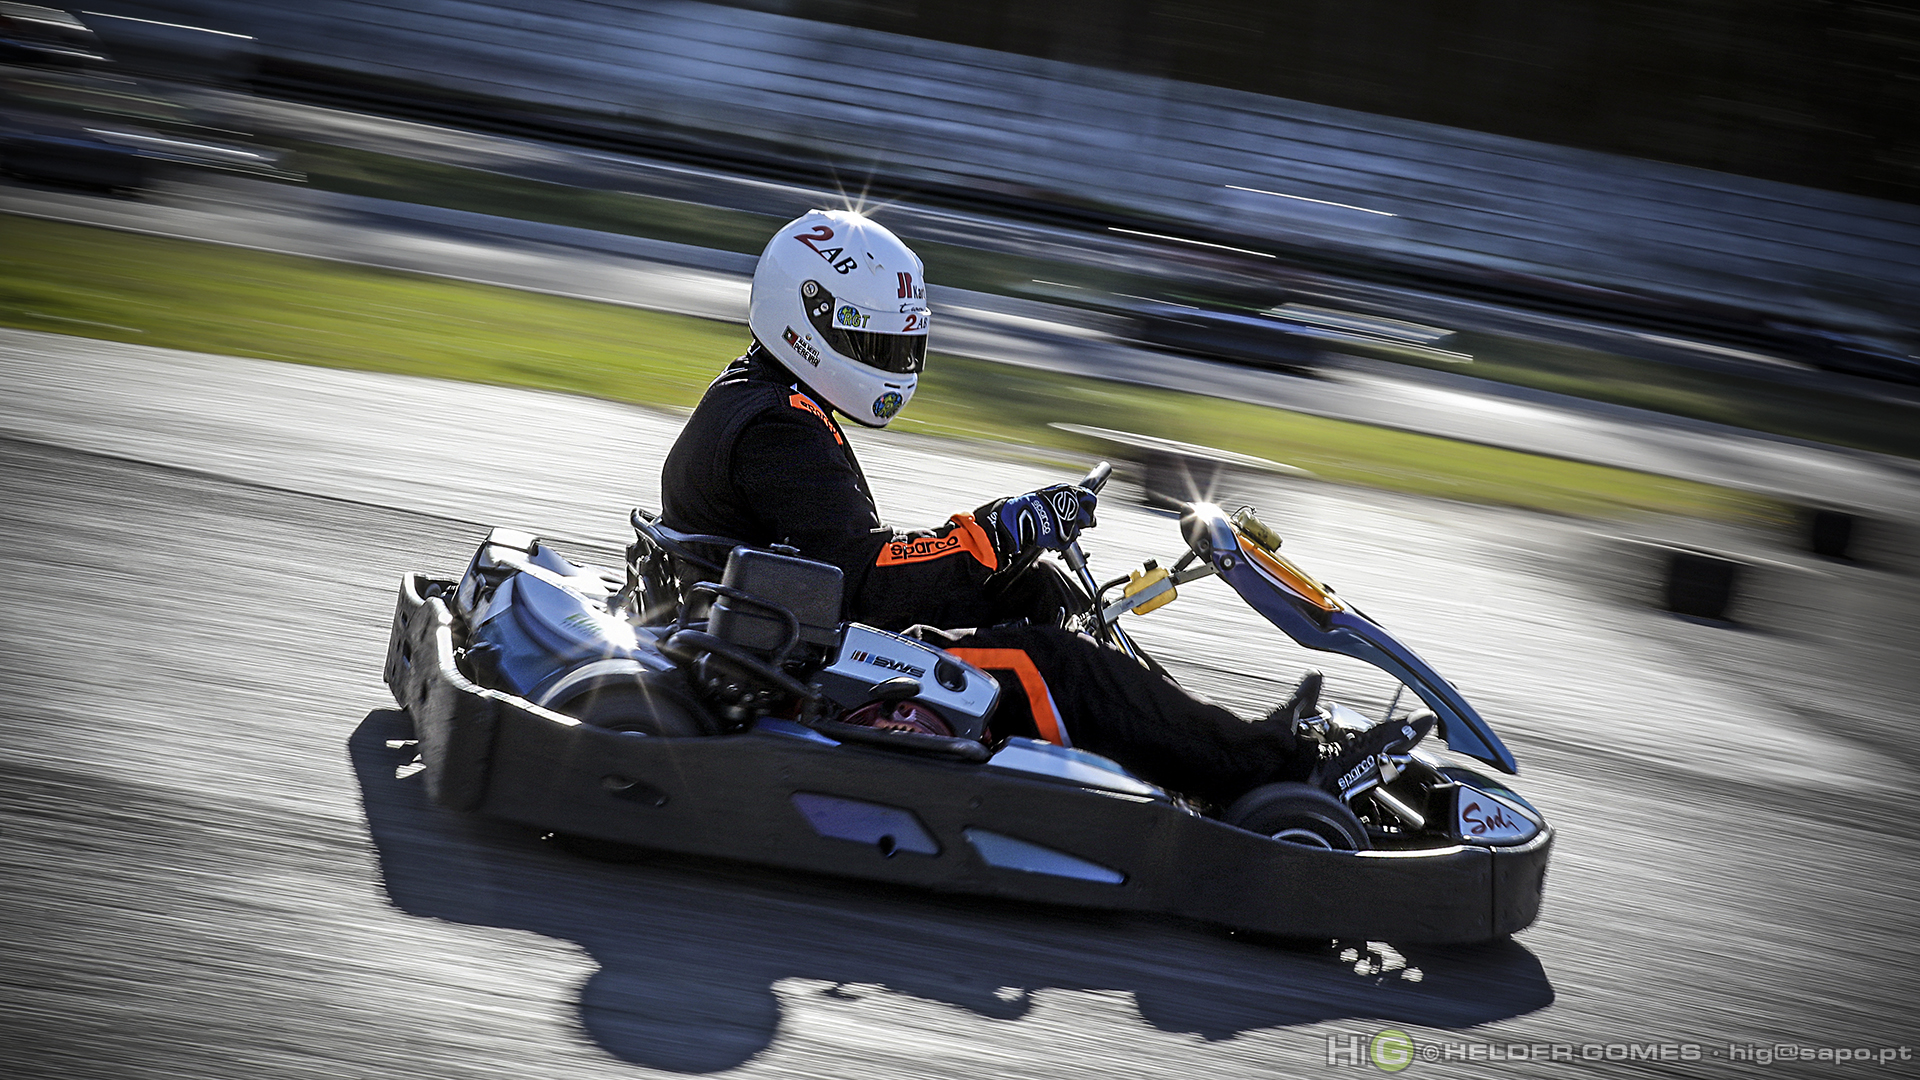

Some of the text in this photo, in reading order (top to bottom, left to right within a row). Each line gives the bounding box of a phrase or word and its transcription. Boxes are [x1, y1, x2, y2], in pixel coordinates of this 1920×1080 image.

[793, 225, 858, 275] 2AB
[897, 271, 913, 299] JR
[842, 311, 871, 329] RGT
[1031, 500, 1051, 536] sparco
[890, 536, 962, 560] sparco
[872, 655, 927, 679] SWS
[1337, 754, 1376, 791] sparco
[1462, 801, 1521, 835] Sodi
